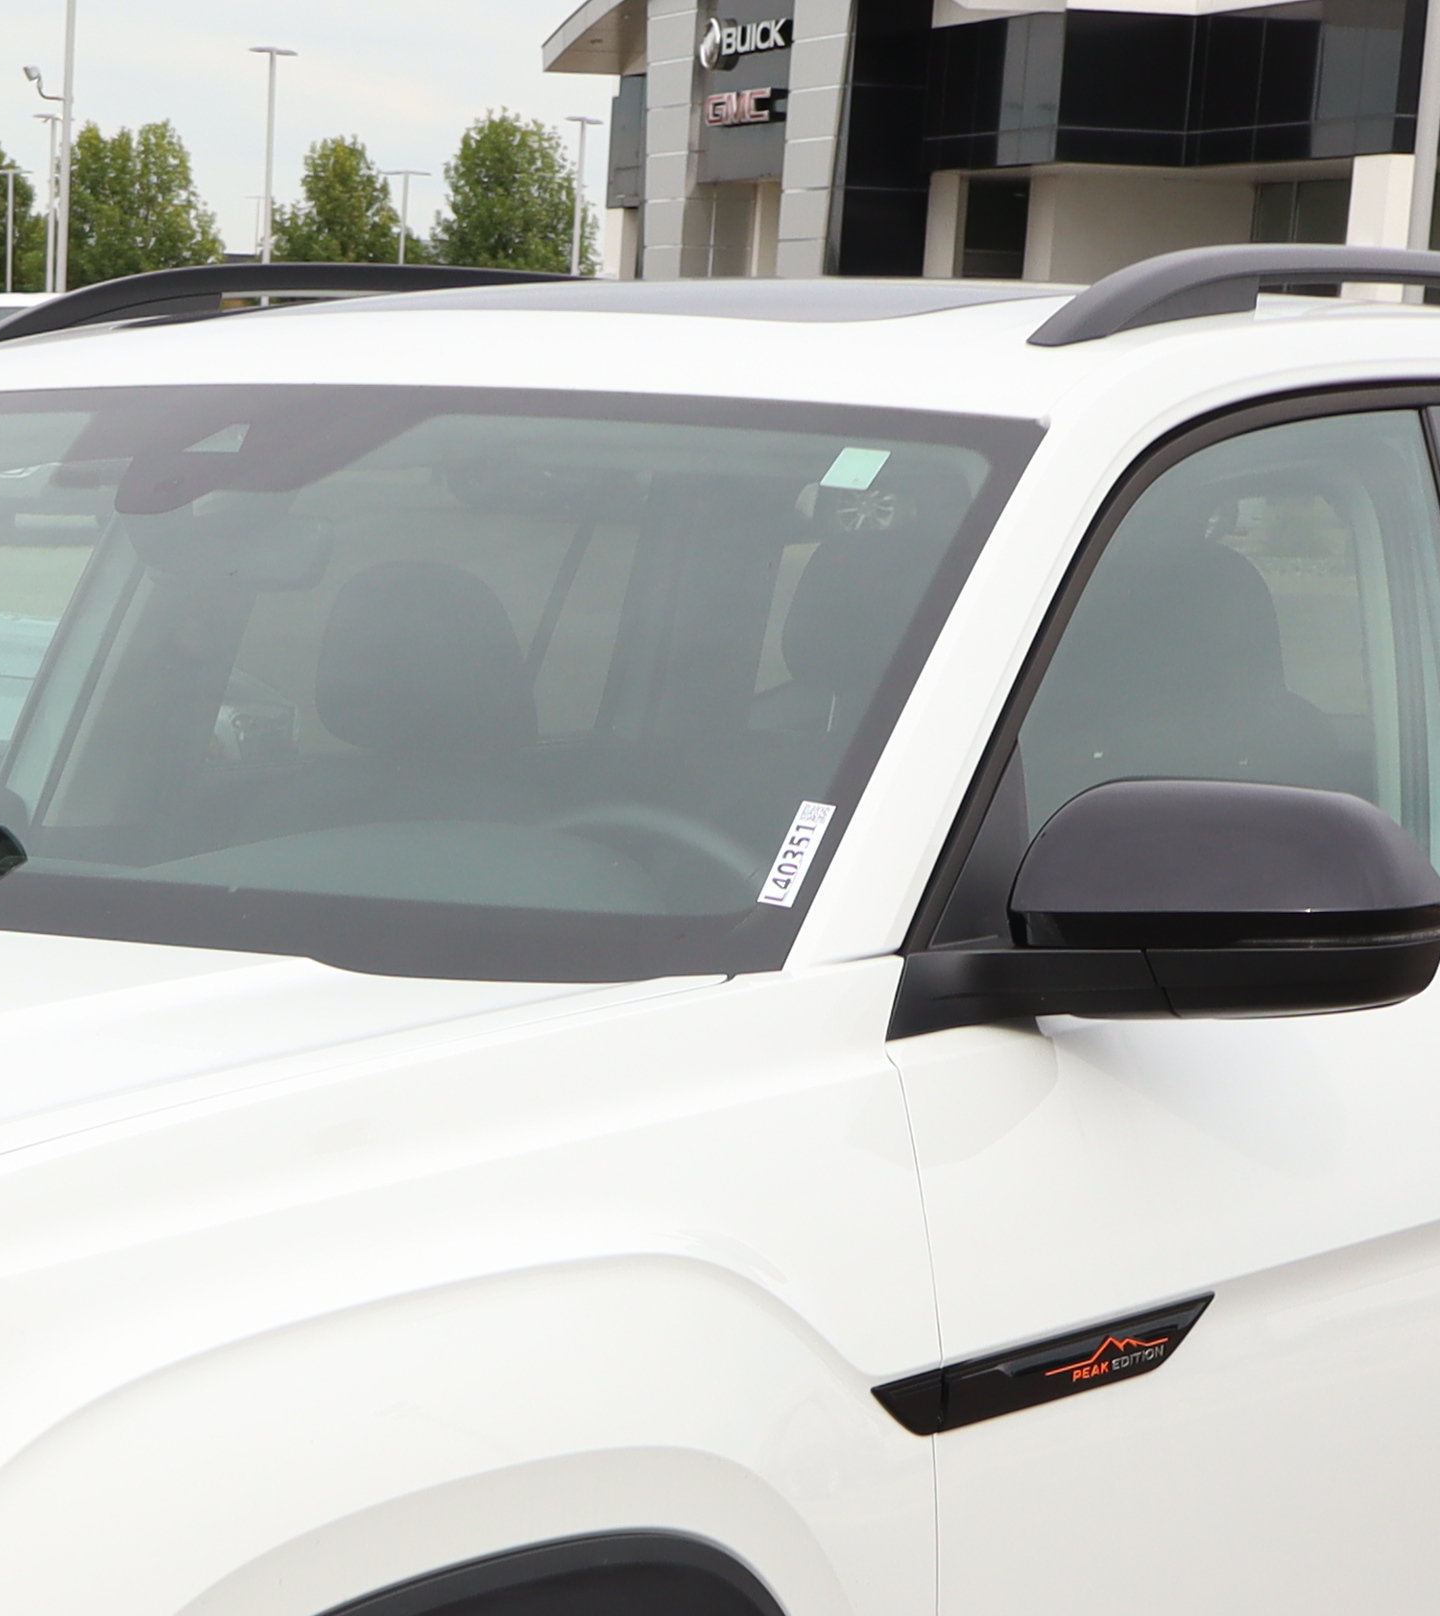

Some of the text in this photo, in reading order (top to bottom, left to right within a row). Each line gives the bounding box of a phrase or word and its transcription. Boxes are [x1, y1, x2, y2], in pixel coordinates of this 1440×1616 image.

[722, 18, 787, 56] BUICK
[706, 87, 772, 125] GMC
[764, 824, 817, 902] L40351
[1072, 1345, 1165, 1382] PEAK EDITION
